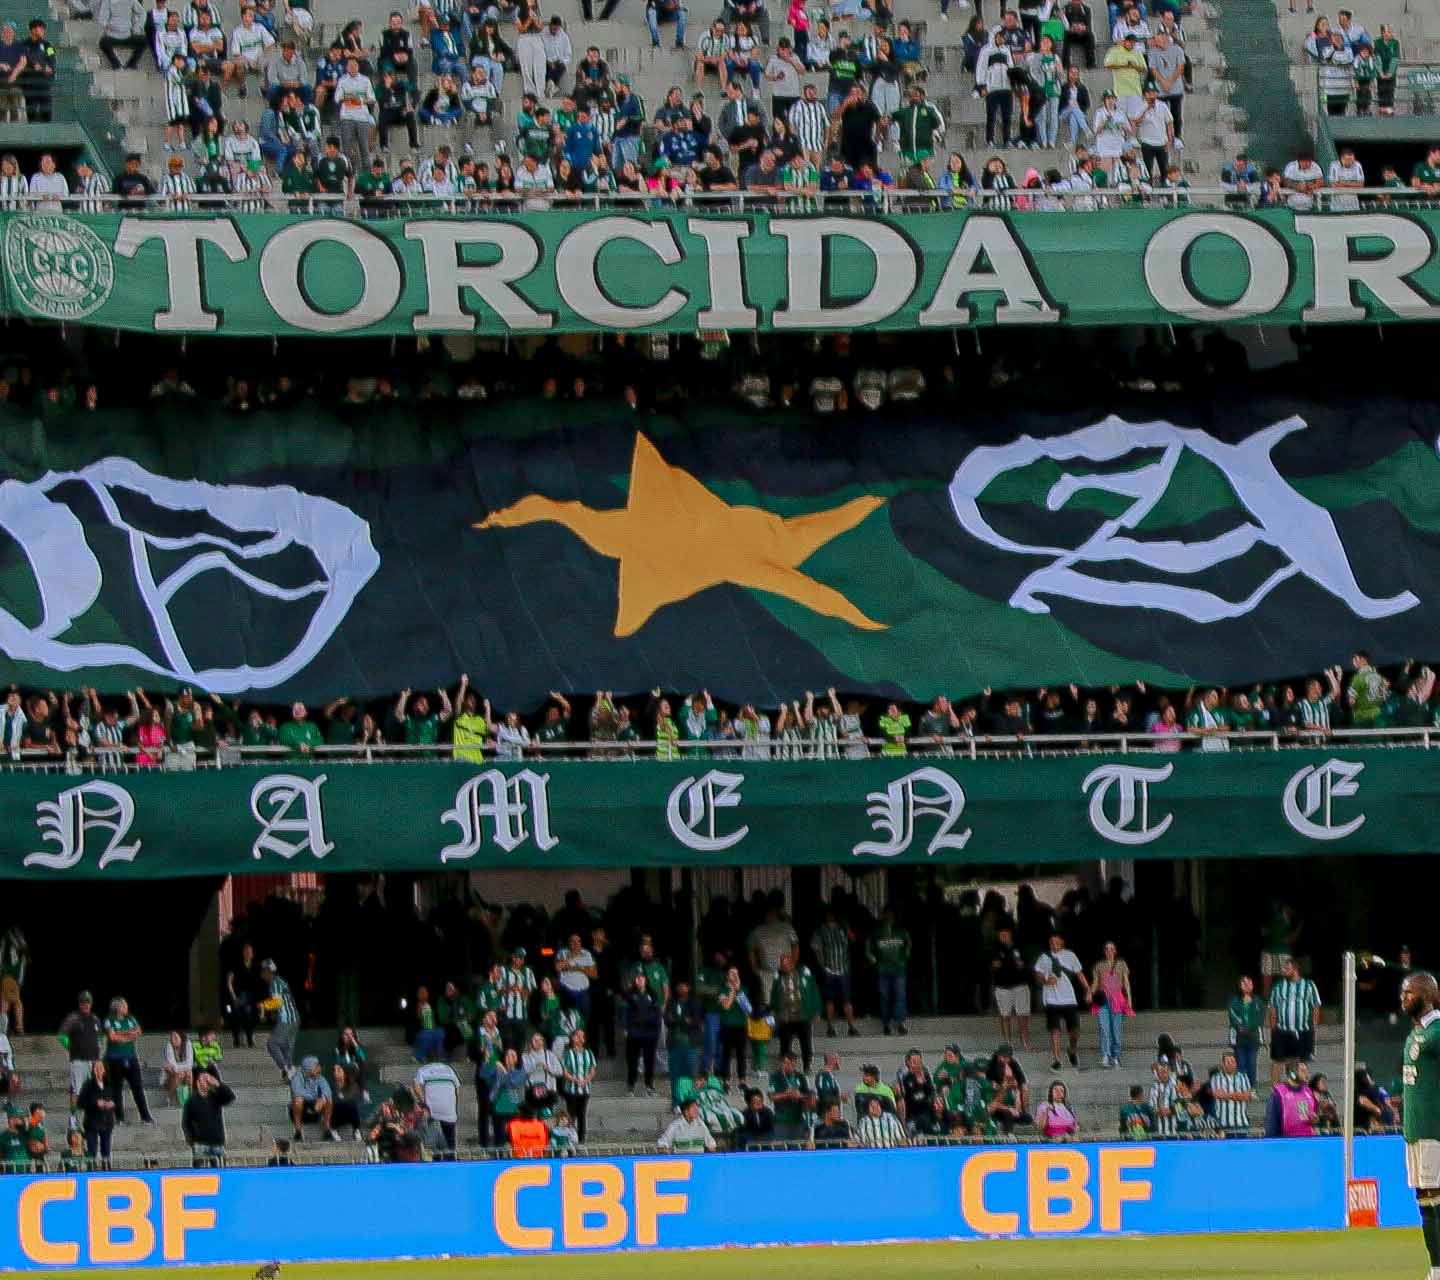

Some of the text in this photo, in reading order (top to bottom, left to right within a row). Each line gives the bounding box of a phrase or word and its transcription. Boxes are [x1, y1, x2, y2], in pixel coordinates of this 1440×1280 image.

[114, 214, 1062, 332] TORCIDA
[17, 1174, 221, 1266] CBF
[493, 1160, 692, 1250] CBF
[960, 1147, 1157, 1235] CBF
